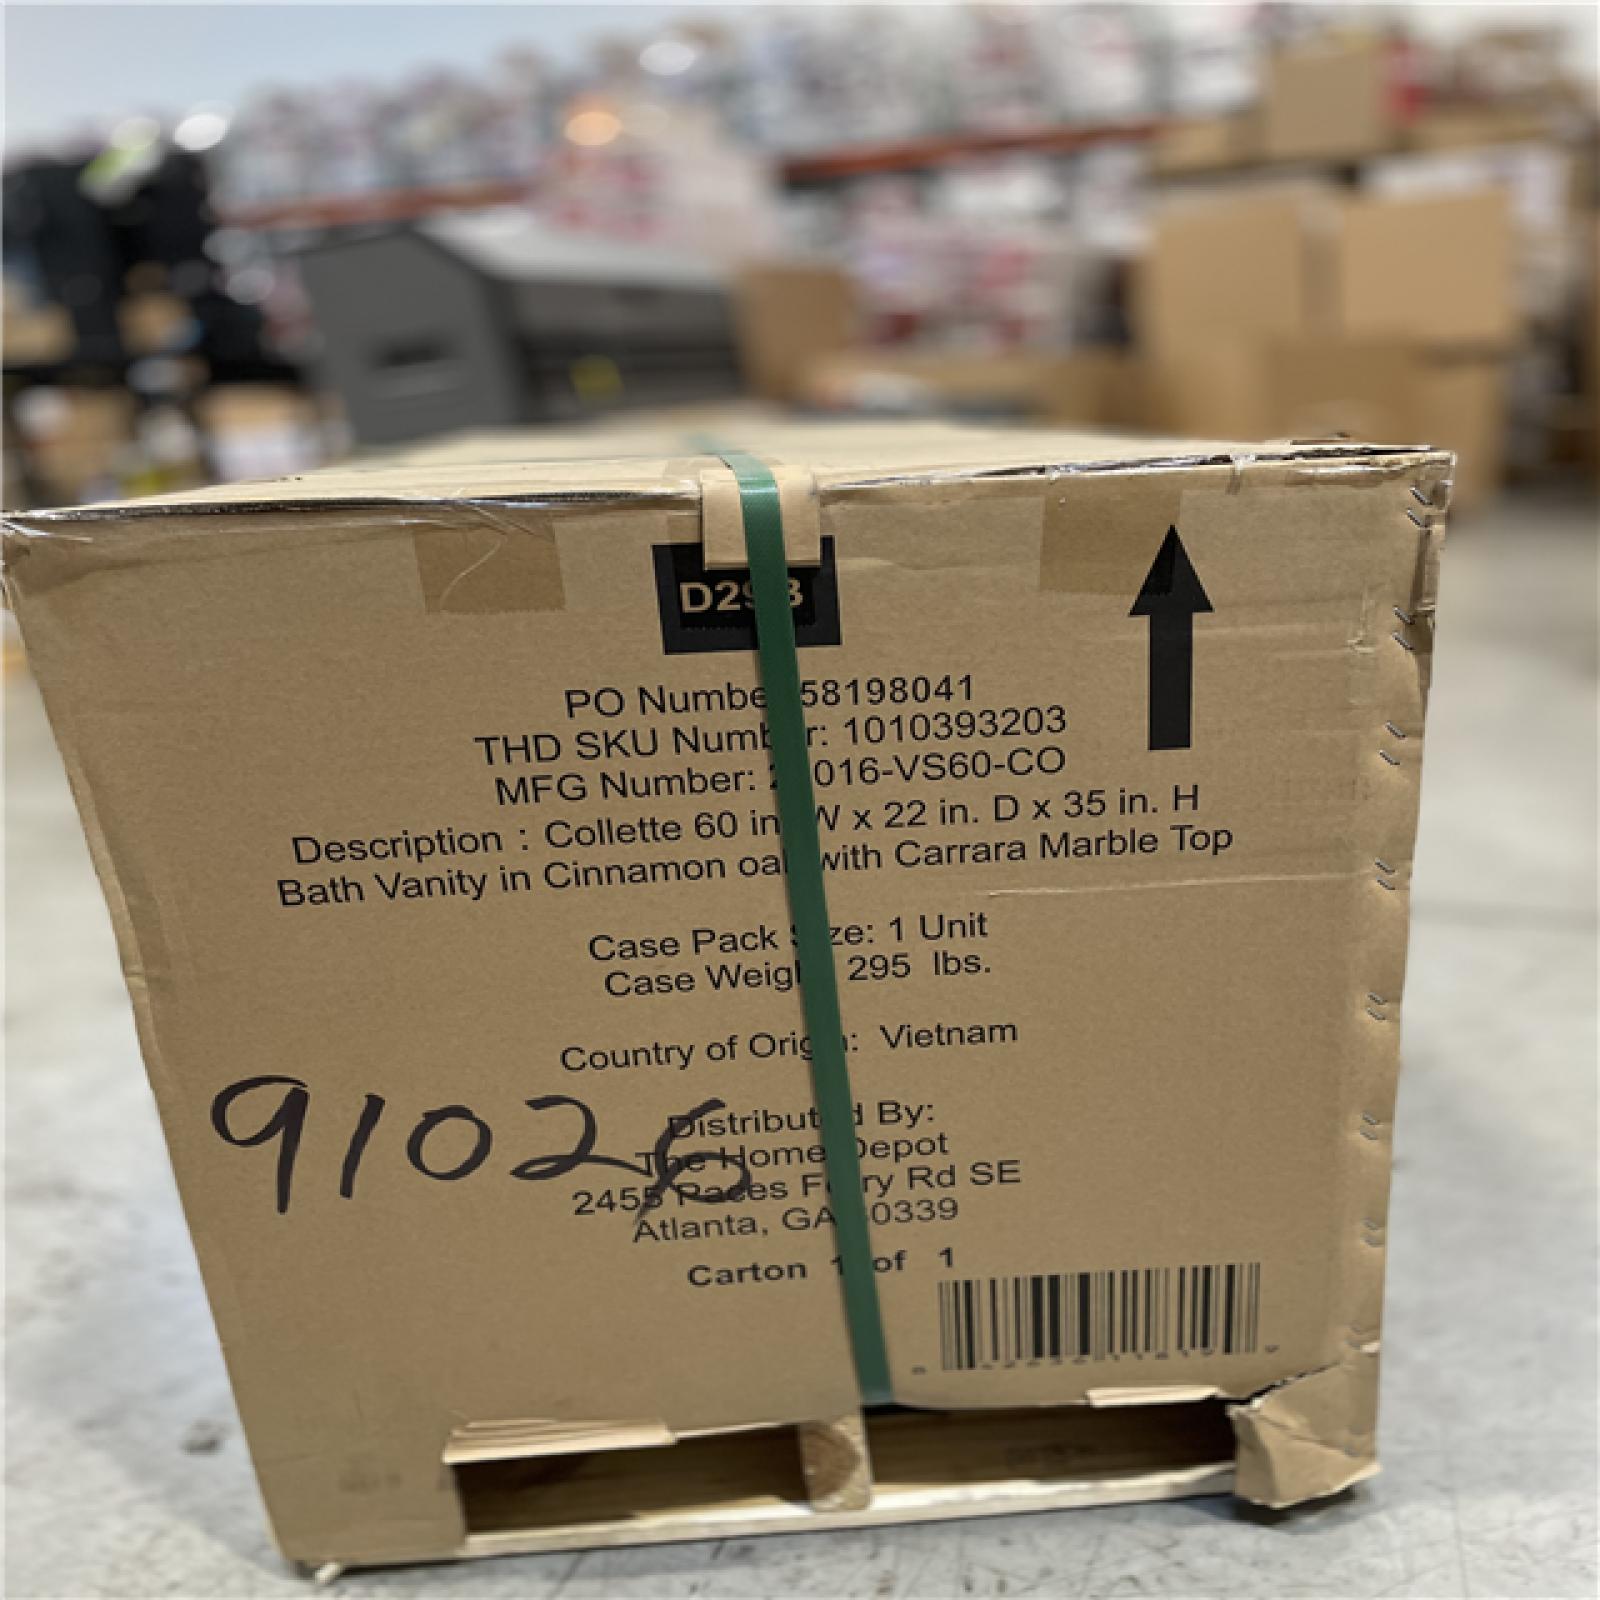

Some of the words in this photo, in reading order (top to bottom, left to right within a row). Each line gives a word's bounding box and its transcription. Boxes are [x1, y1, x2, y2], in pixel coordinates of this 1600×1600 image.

[565, 686, 625, 718] PO
[638, 682, 767, 714] Numbe
[801, 674, 974, 706] 58198041
[475, 735, 561, 766] THD
[575, 727, 659, 760] SKU
[673, 722, 828, 754] Numbr:
[843, 704, 1068, 745] 1010393203
[495, 773, 588, 806] MFG
[600, 766, 756, 800] Number:
[770, 745, 1067, 789] 016-VS60-CO
[292, 828, 503, 865] Description
[544, 816, 683, 849] Collette
[694, 810, 738, 839] 60
[750, 808, 781, 836] in
[852, 808, 873, 830] x
[884, 800, 927, 828] 22
[939, 798, 979, 825] in.
[993, 794, 1020, 822] D
[1031, 798, 1052, 819] x
[1064, 790, 1107, 818] 35
[1118, 786, 1159, 815] in.
[1174, 783, 1200, 811] H
[277, 875, 365, 907] Bath
[374, 868, 488, 901] Vanity
[500, 865, 531, 892] in
[543, 855, 726, 890] Cinnamon
[738, 848, 789, 877] oa
[821, 844, 882, 871] with
[894, 839, 1027, 868] Carrara
[1039, 826, 1160, 859] Marble
[1170, 823, 1234, 856] Top
[588, 932, 681, 961] Case
[691, 924, 779, 955] Pack
[790, 924, 874, 947] ze:
[889, 917, 905, 941] 1
[919, 911, 989, 940] Unit
[604, 968, 697, 996] Case
[704, 960, 801, 993] Weig
[847, 953, 912, 981] 295
[933, 949, 992, 975] lbs.
[560, 1040, 696, 1071] Country
[706, 1034, 738, 1060] of
[748, 1028, 858, 1061] Orig:
[879, 1021, 1018, 1050] Vietnam
[667, 1108, 864, 1138] Distribut
[879, 1101, 934, 1127] By:
[210, 1075, 752, 1216] 91026
[634, 1149, 707, 1173] Te
[719, 1143, 826, 1170] Home
[573, 1184, 662, 1215] 2455
[802, 1170, 893, 1198] Fry
[907, 1163, 956, 1190] Rd
[969, 1159, 1021, 1186] SE
[633, 1214, 769, 1243] Atlanta,
[782, 1206, 837, 1231] GA
[871, 1197, 959, 1225] 0339
[686, 1260, 807, 1287] Carton
[873, 1249, 908, 1273] of
[938, 1246, 954, 1268] 1
